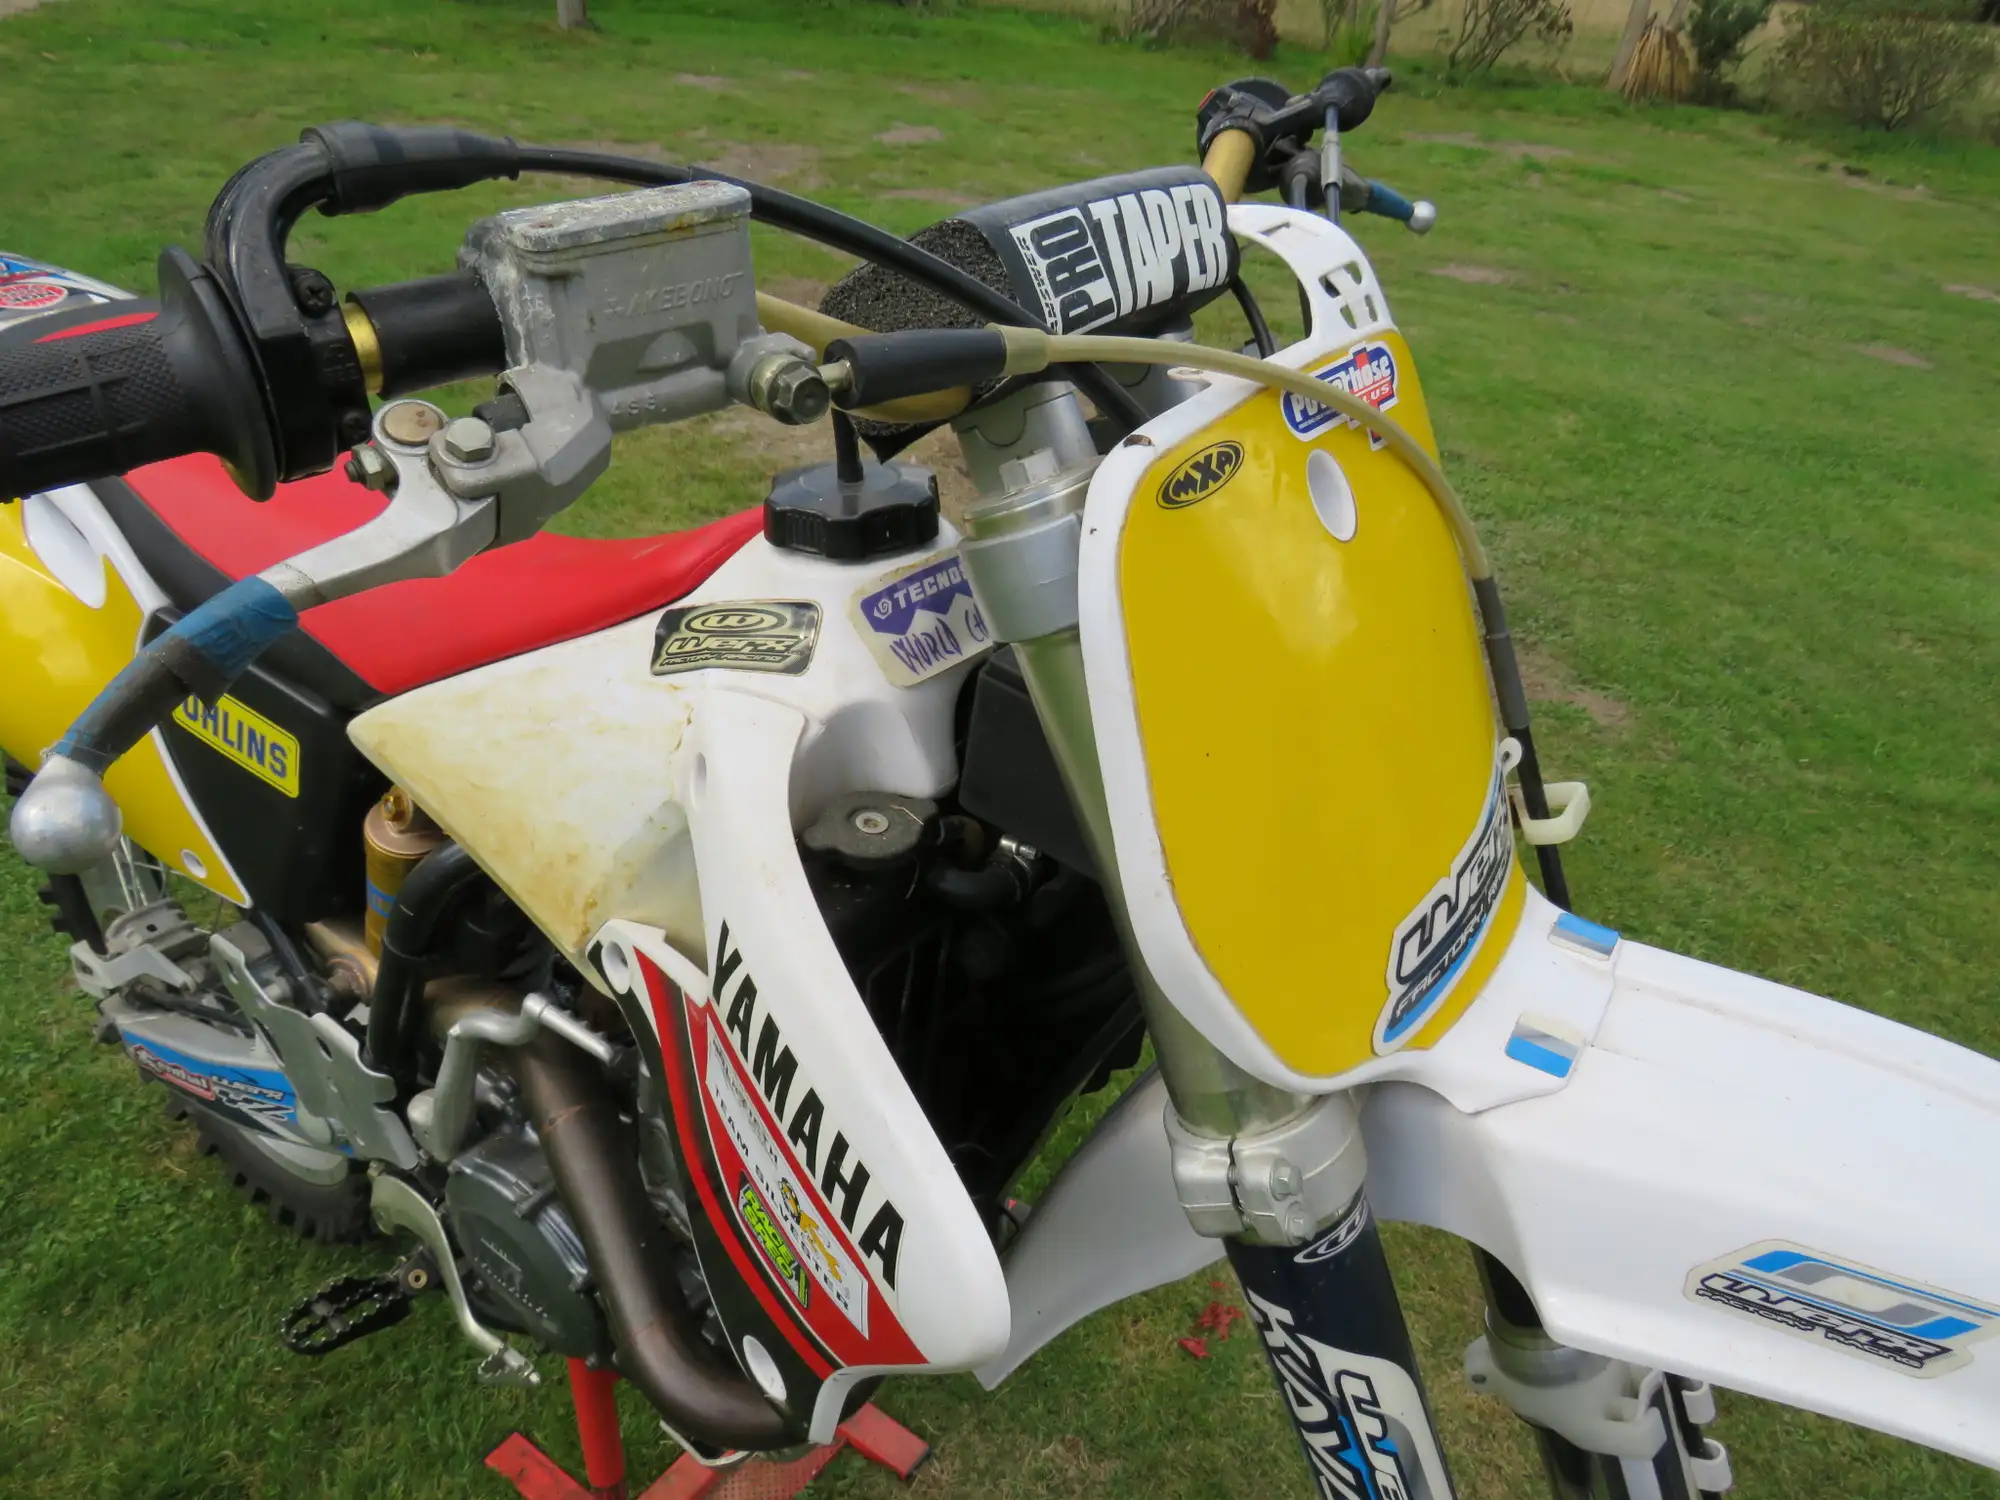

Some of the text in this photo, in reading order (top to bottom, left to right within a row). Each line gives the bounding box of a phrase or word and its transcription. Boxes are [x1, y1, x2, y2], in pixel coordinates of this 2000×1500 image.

[1030, 214, 1116, 335] PRO
[1088, 183, 1229, 318] TAPER
[1395, 903, 1488, 1019] FACTORY
[713, 918, 905, 1292] YAMAHA
[715, 1083, 749, 1158] TEAM
[755, 1164, 849, 1310] SILVESTER
[742, 1203, 794, 1280] SPEC
[743, 1187, 795, 1267] RACE
[1695, 1287, 1925, 1369] FACTORY RACING
